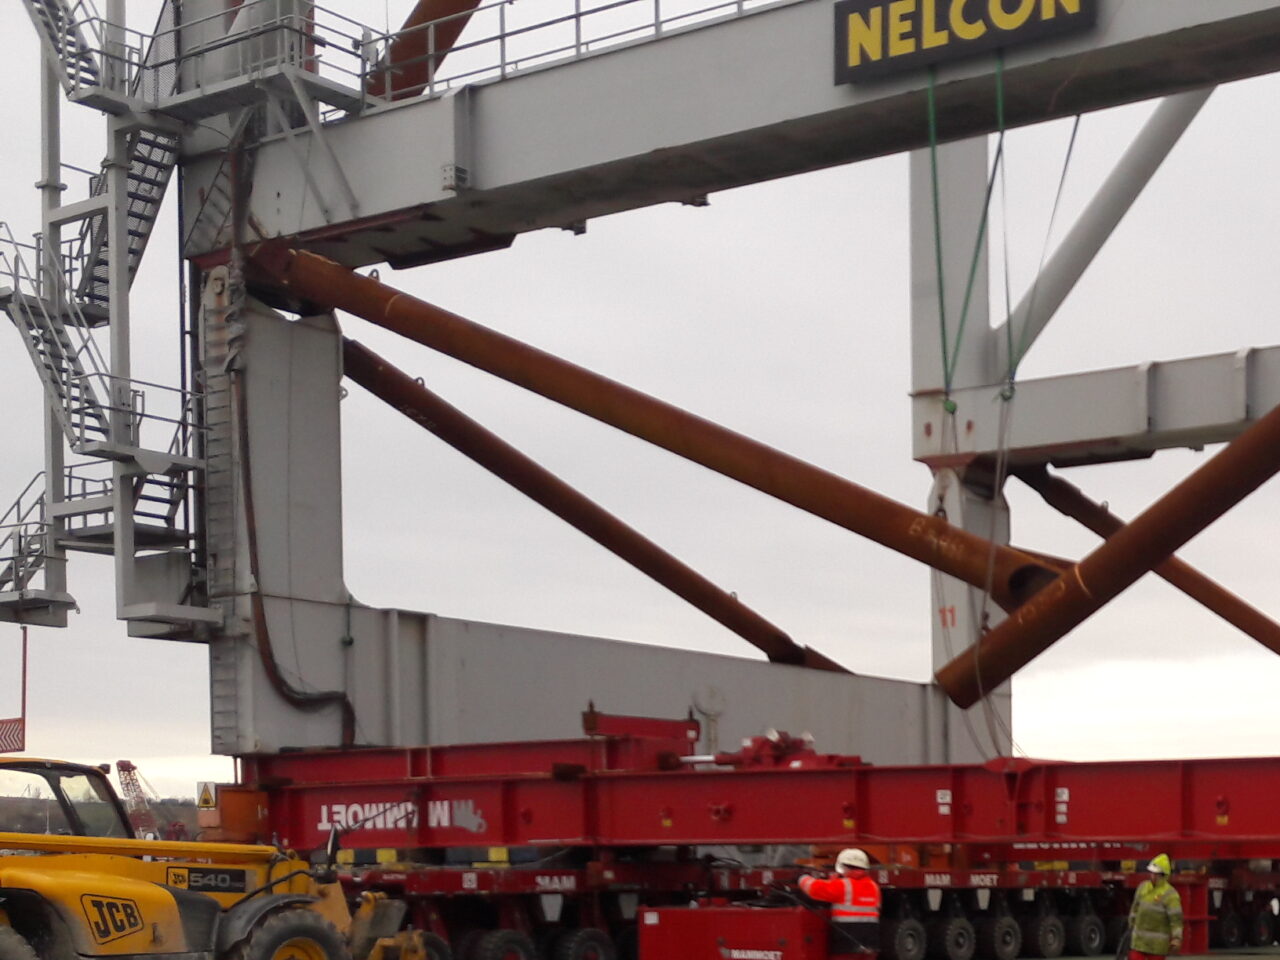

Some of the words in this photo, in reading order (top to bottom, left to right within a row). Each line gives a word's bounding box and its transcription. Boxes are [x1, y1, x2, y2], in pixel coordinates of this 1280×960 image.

[189, 872, 231, 887] 540
[91, 900, 139, 938] JCB
[731, 949, 784, 960] MAMMOET
